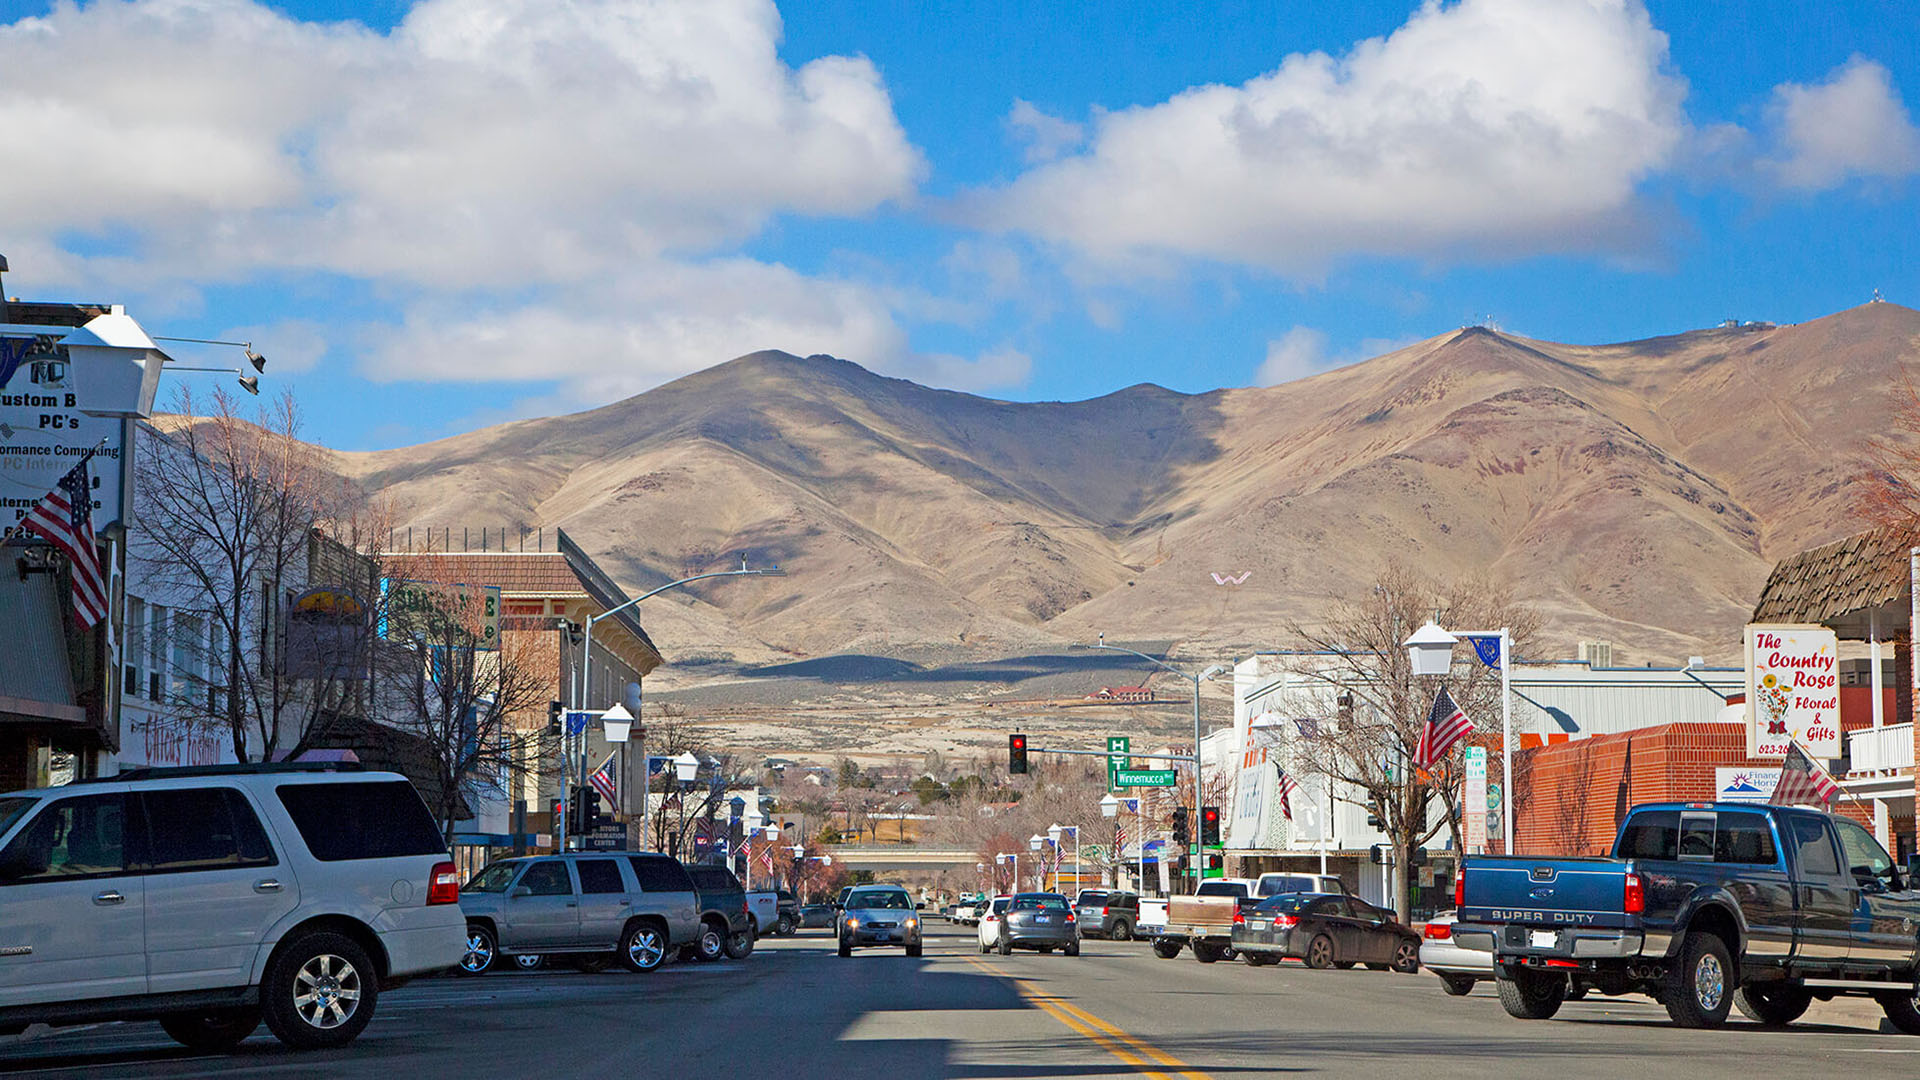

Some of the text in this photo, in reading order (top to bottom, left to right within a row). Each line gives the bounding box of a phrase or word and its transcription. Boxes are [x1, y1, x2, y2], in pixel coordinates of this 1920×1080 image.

[0, 393, 58, 407] ustom
[39, 414, 79, 429] PC's
[0, 445, 51, 456] ormance
[4, 456, 70, 470] PC Intern
[0, 497, 44, 508] terne
[4, 526, 37, 539] 625-
[1757, 633, 1782, 649] The
[1768, 651, 1835, 673] Country
[1793, 670, 1836, 690] Rose
[1795, 696, 1837, 710] Floral
[1813, 712, 1822, 725] &
[1806, 727, 1836, 742] Gifts
[1758, 744, 1790, 755] 623-26
[1111, 740, 1125, 791] HOTL
[1119, 773, 1165, 784] Winnemucca
[1754, 779, 1778, 787] Horiz
[1492, 910, 1543, 921] SUPER
[1554, 914, 1595, 923] DUTY
